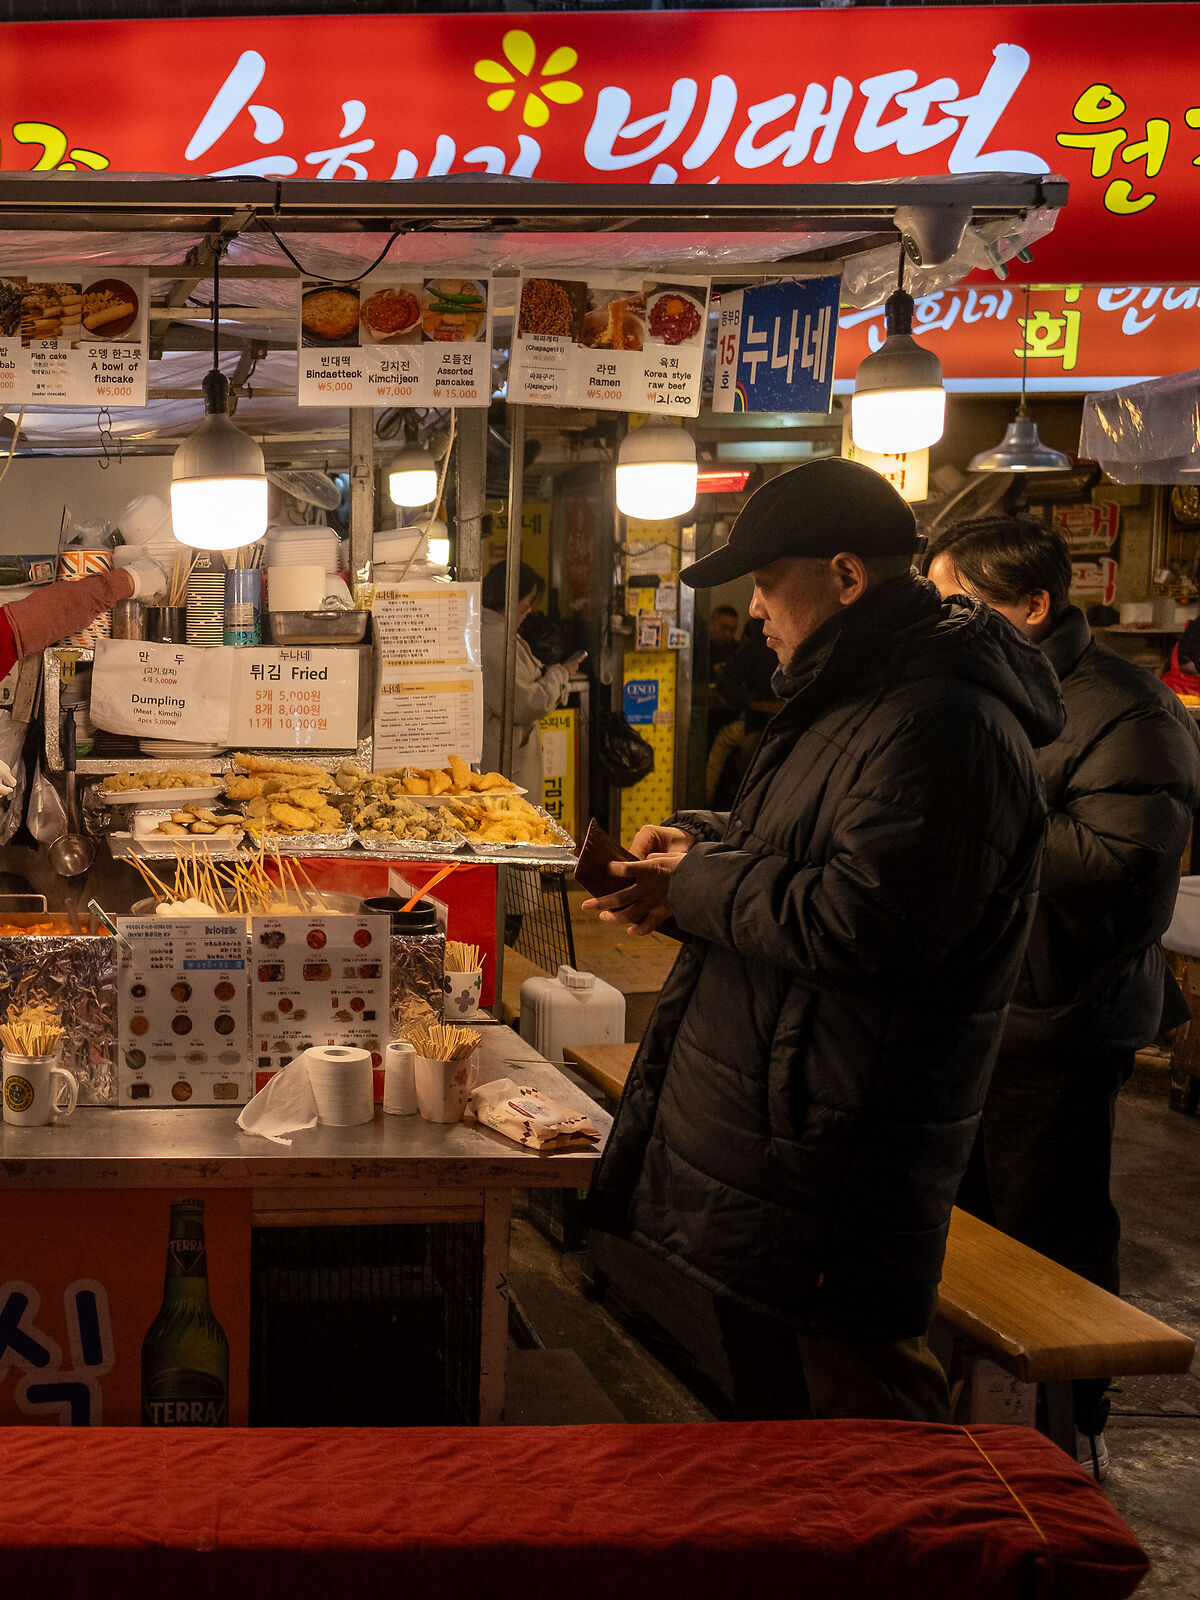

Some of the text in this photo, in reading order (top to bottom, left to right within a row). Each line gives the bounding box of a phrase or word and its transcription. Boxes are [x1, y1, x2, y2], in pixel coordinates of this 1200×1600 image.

[1056, 82, 1200, 215] 원
[722, 310, 740, 326] 동부B
[720, 335, 736, 365] 15
[742, 306, 832, 385] 누나네
[88, 349, 142, 360] 오뎅 한그릇
[91, 362, 138, 371] A bowl of
[321, 356, 351, 367] 빈대떡
[659, 358, 679, 369] 육회
[306, 370, 362, 379] Bindaetteok
[437, 367, 473, 376] Assorted
[596, 364, 617, 375] 라면
[644, 370, 692, 380] Korea style
[94, 375, 134, 384] fishcake
[368, 374, 419, 385] Kimchijeon
[435, 379, 475, 387] pancakes
[589, 377, 621, 387] Ramen
[721, 371, 729, 389] 호
[318, 383, 353, 392] ₩5,000
[377, 387, 412, 396] ₩7,000
[668, 382, 686, 390] beef
[587, 390, 622, 399] ₩5,000
[139, 651, 185, 665] 만 두
[280, 650, 310, 661] 누나네
[250, 664, 328, 681] 튀김 Fried
[131, 694, 186, 708] Dumpling
[256, 690, 321, 703] 5개 5,000원
[255, 704, 321, 716] 8개 8,000원
[249, 718, 327, 730] 11개 10,000원
[169, 1240, 204, 1251] TERRA
[150, 1401, 218, 1425] TERRA
